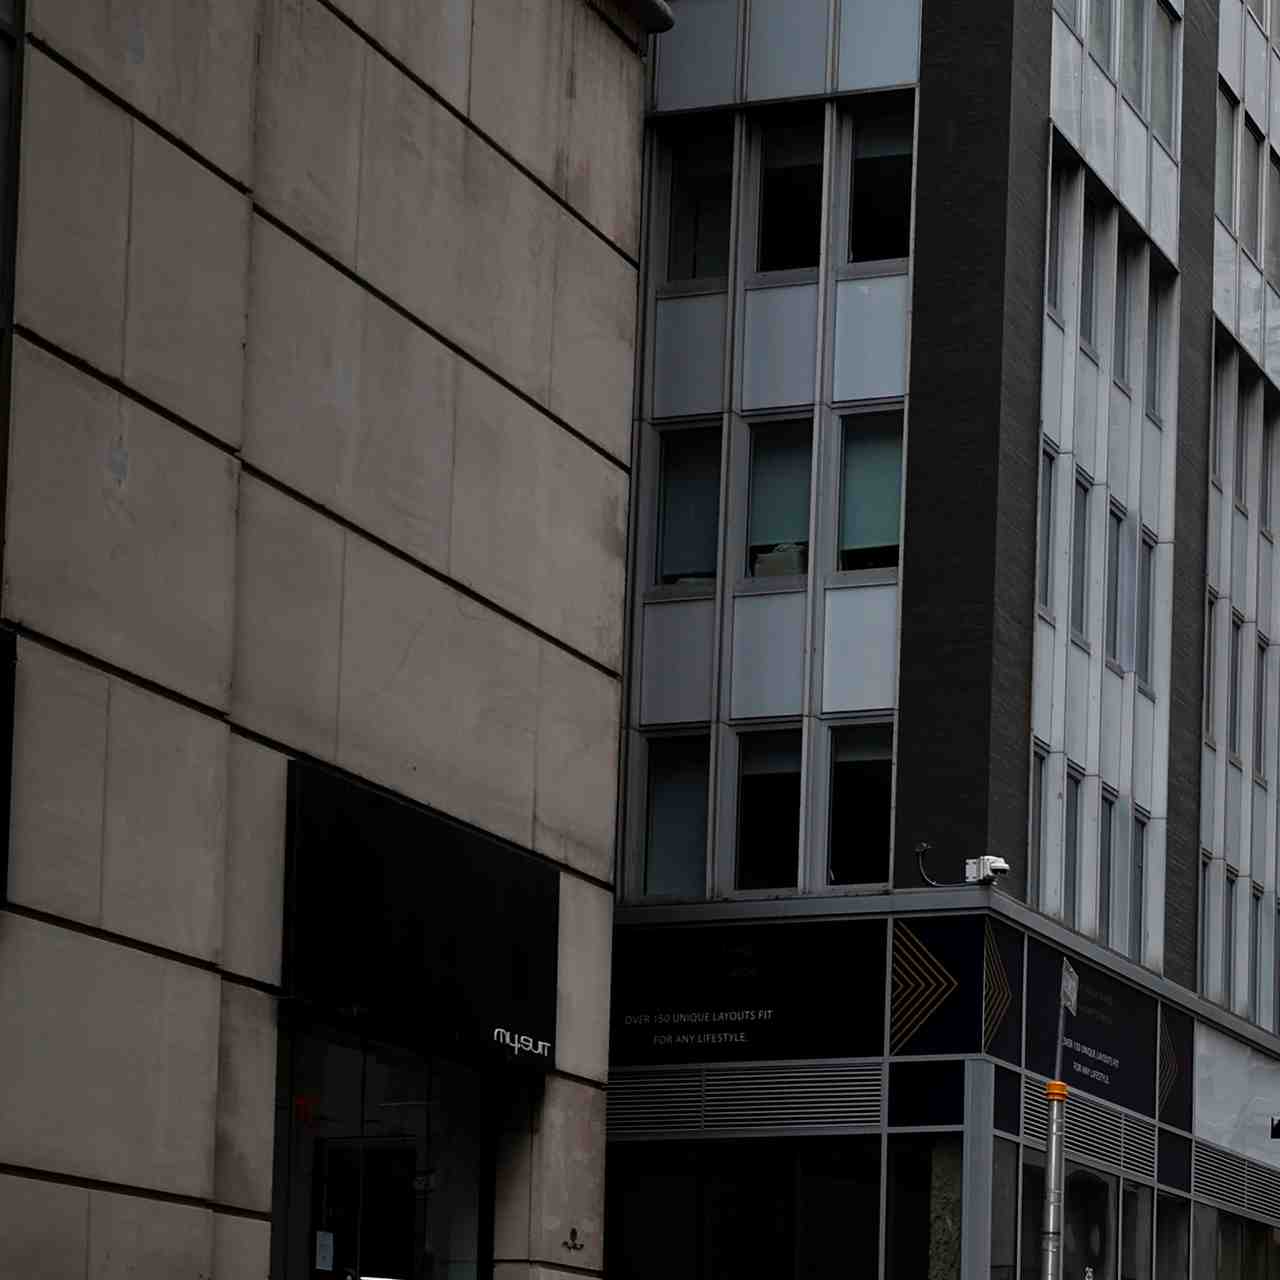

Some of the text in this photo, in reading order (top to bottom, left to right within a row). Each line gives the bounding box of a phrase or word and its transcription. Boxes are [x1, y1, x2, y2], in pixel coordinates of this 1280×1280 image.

[672, 1011, 712, 1023] UNIQUE
[713, 1010, 757, 1022] LAYOUTS
[758, 1009, 774, 1020] FIT
